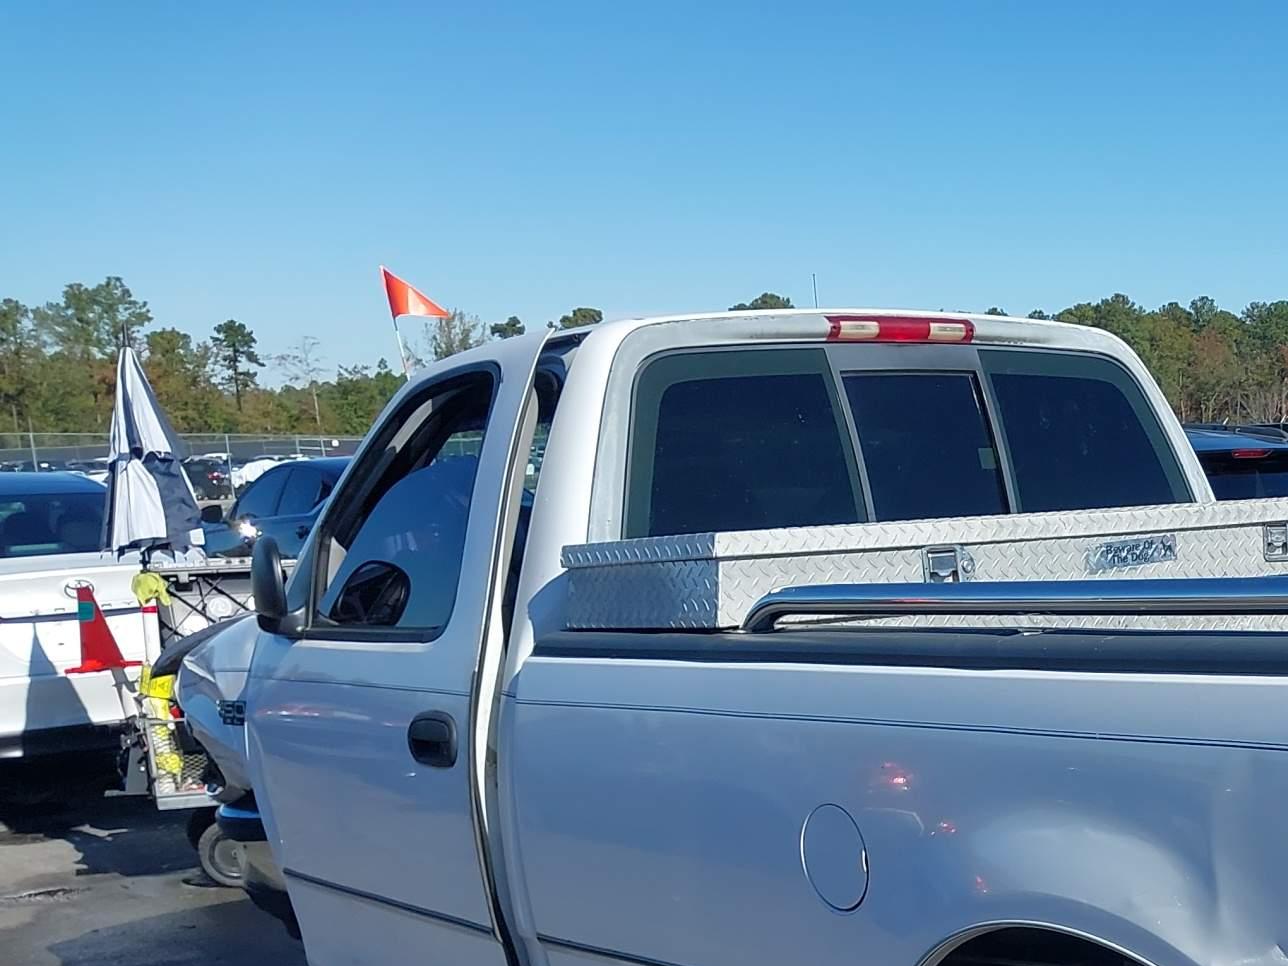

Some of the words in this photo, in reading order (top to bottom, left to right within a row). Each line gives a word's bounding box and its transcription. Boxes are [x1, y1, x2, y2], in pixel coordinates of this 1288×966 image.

[1106, 543, 1141, 556] Beware
[1142, 539, 1154, 551] Of
[1112, 553, 1129, 564] The
[1131, 551, 1150, 563] Dog
